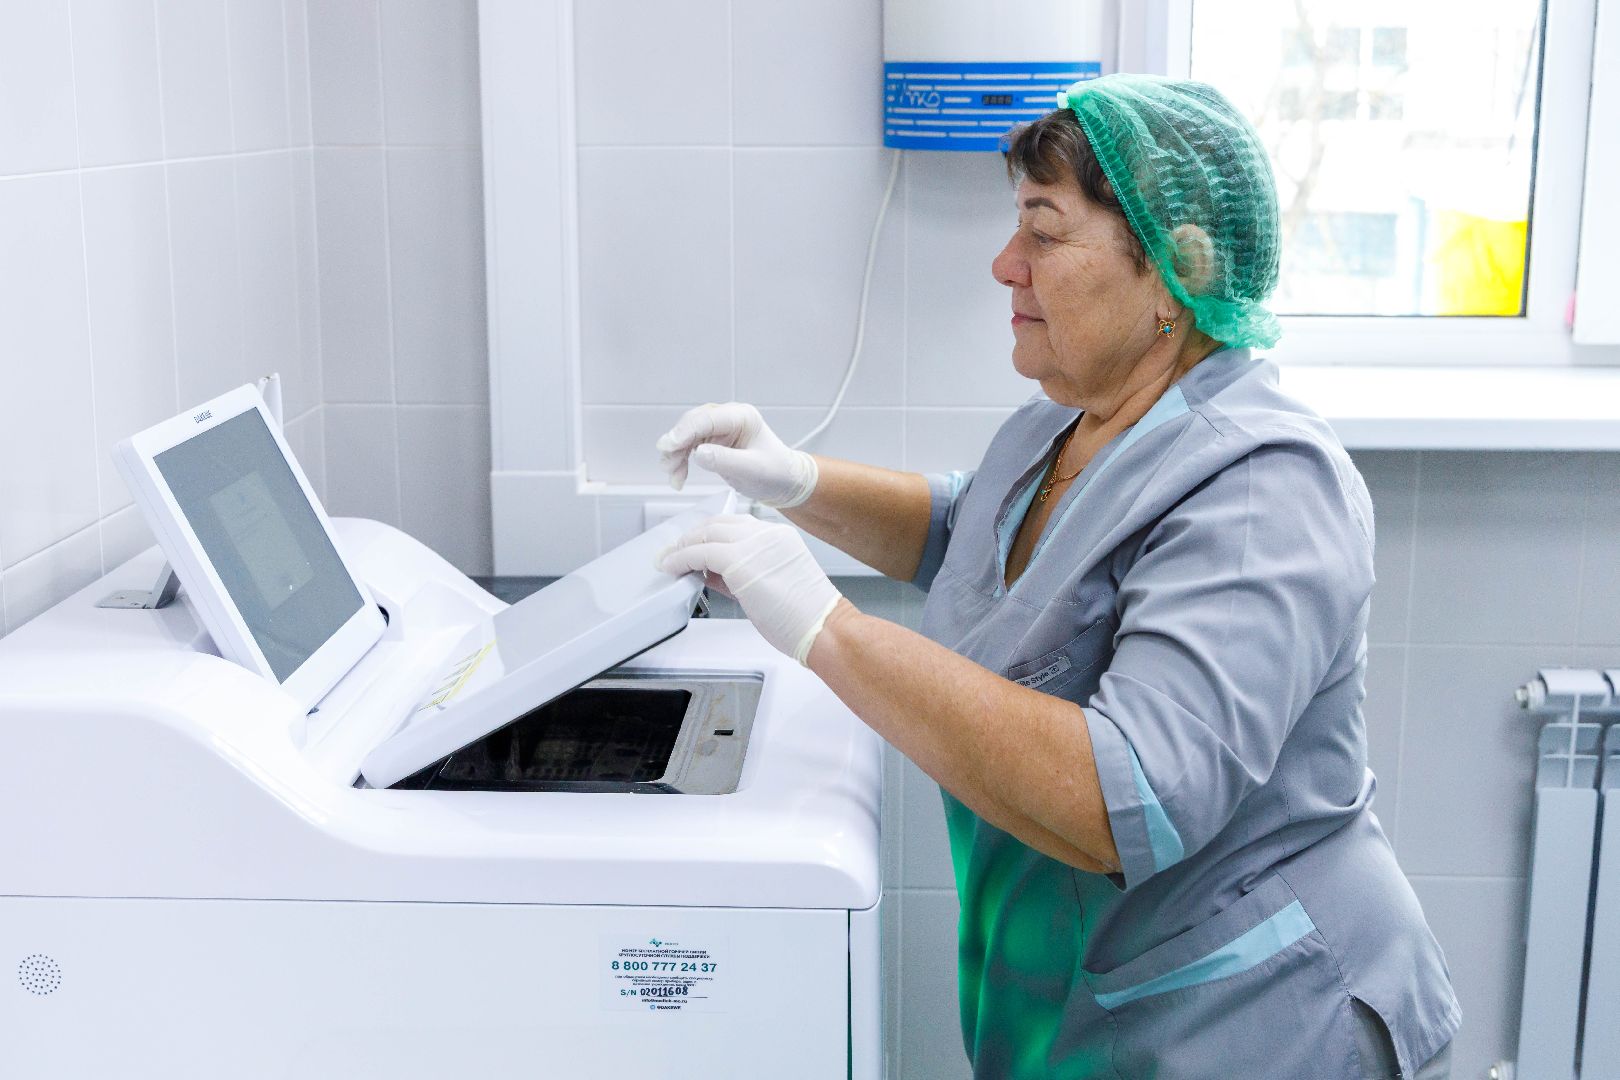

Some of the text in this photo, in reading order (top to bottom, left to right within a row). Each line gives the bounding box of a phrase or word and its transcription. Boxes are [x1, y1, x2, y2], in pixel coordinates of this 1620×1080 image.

[1031, 672, 1050, 683] Style
[611, 960, 717, 973] 8 800 777 24 37
[620, 989, 637, 998] S/N
[640, 985, 689, 998] 02011608
